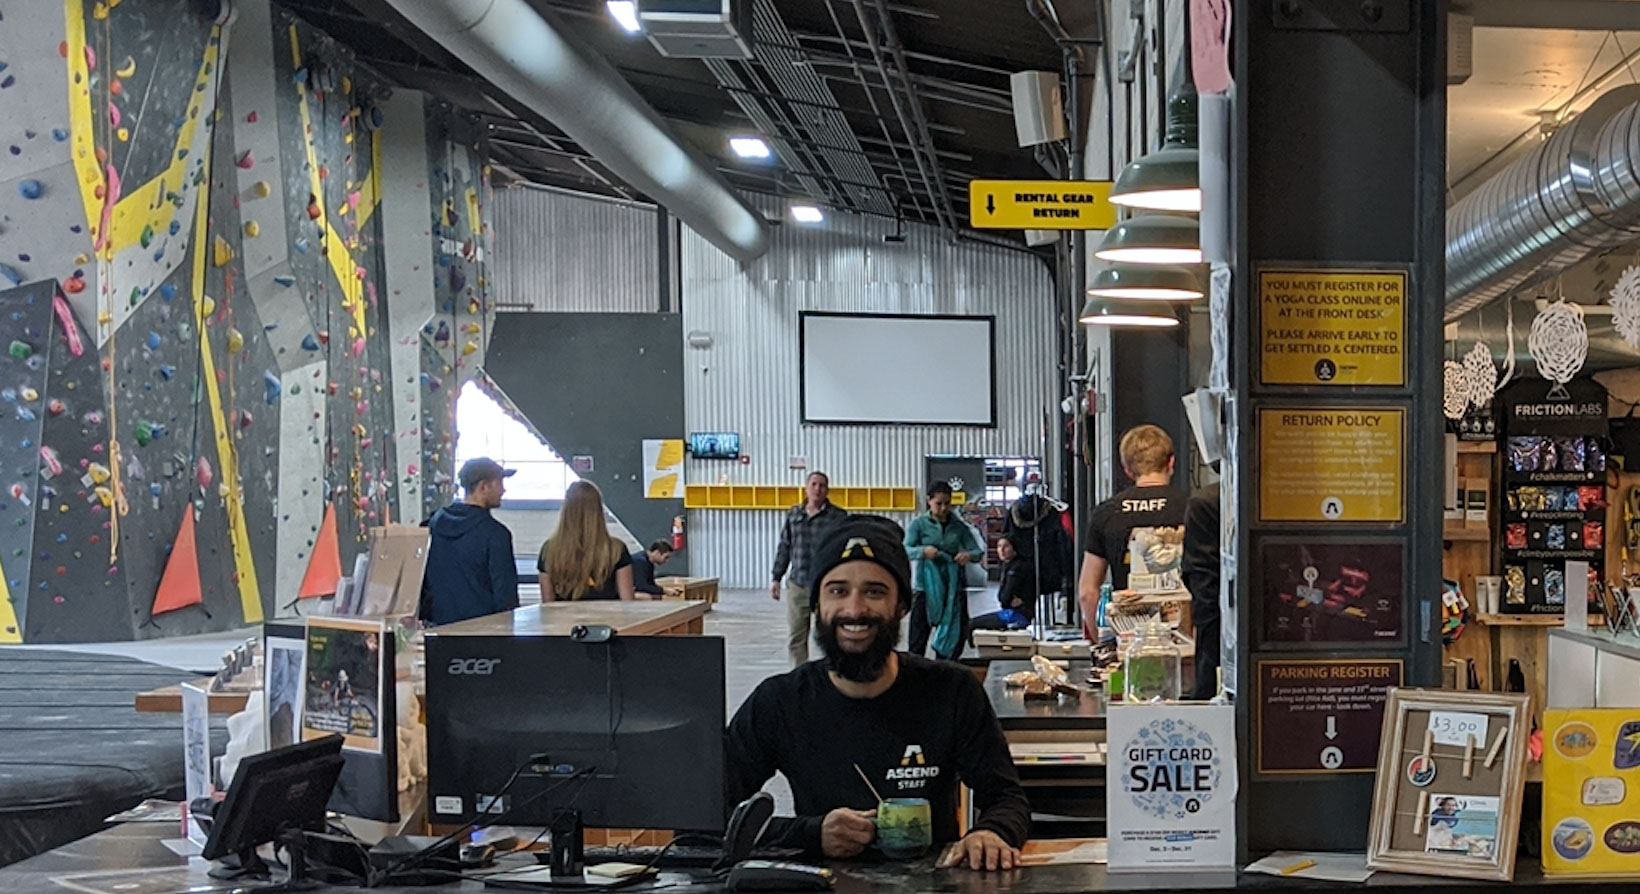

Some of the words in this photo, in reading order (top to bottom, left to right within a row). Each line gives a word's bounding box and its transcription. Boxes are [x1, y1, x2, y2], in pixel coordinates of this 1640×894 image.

[1015, 193, 1059, 203] RENTAL
[1062, 193, 1094, 203] GEAR
[1033, 208, 1079, 218] RETURN
[1266, 281, 1290, 290] YOU
[1292, 281, 1321, 290] MUST
[1325, 281, 1375, 291] REGISTER
[1377, 282, 1399, 291] FOR
[1264, 295, 1272, 303] A
[1274, 295, 1304, 303] YOGA
[1308, 295, 1339, 304] CLASS
[1342, 295, 1381, 305] ONLINE
[1384, 296, 1400, 305] OR
[1279, 309, 1291, 317] AT
[1295, 309, 1314, 318] THE
[1318, 309, 1353, 318] FRONT
[1266, 330, 1304, 339] PLEASE
[1307, 330, 1345, 340] ARRIVE
[1348, 331, 1379, 340] EARLY
[1383, 331, 1398, 340] TO
[1265, 344, 1284, 353] GET
[1287, 344, 1331, 353] SETTLED
[1333, 344, 1341, 353] &
[1343, 345, 1400, 354] CENTERED.
[1515, 403, 1602, 416] FRICTIONLABS
[1282, 415, 1333, 426] RETURN
[1336, 415, 1381, 426] POLICY
[1530, 472, 1586, 481] #chalkmatters
[1121, 498, 1167, 512] STAFF
[1530, 604, 1564, 612] #friction
[448, 658, 502, 675] acer
[1271, 666, 1328, 679] PARKING
[1331, 666, 1390, 678] REGISTER
[1279, 687, 1291, 695] you
[1291, 686, 1308, 695] park
[1315, 686, 1327, 694] the
[1267, 695, 1295, 704] parking
[1433, 716, 1477, 732] $3.00
[1129, 748, 1165, 762] GIFT
[1169, 748, 1213, 761] CARD
[885, 766, 940, 780] ASCEND
[1130, 764, 1212, 792] SALE
[897, 779, 927, 790] STAFF
